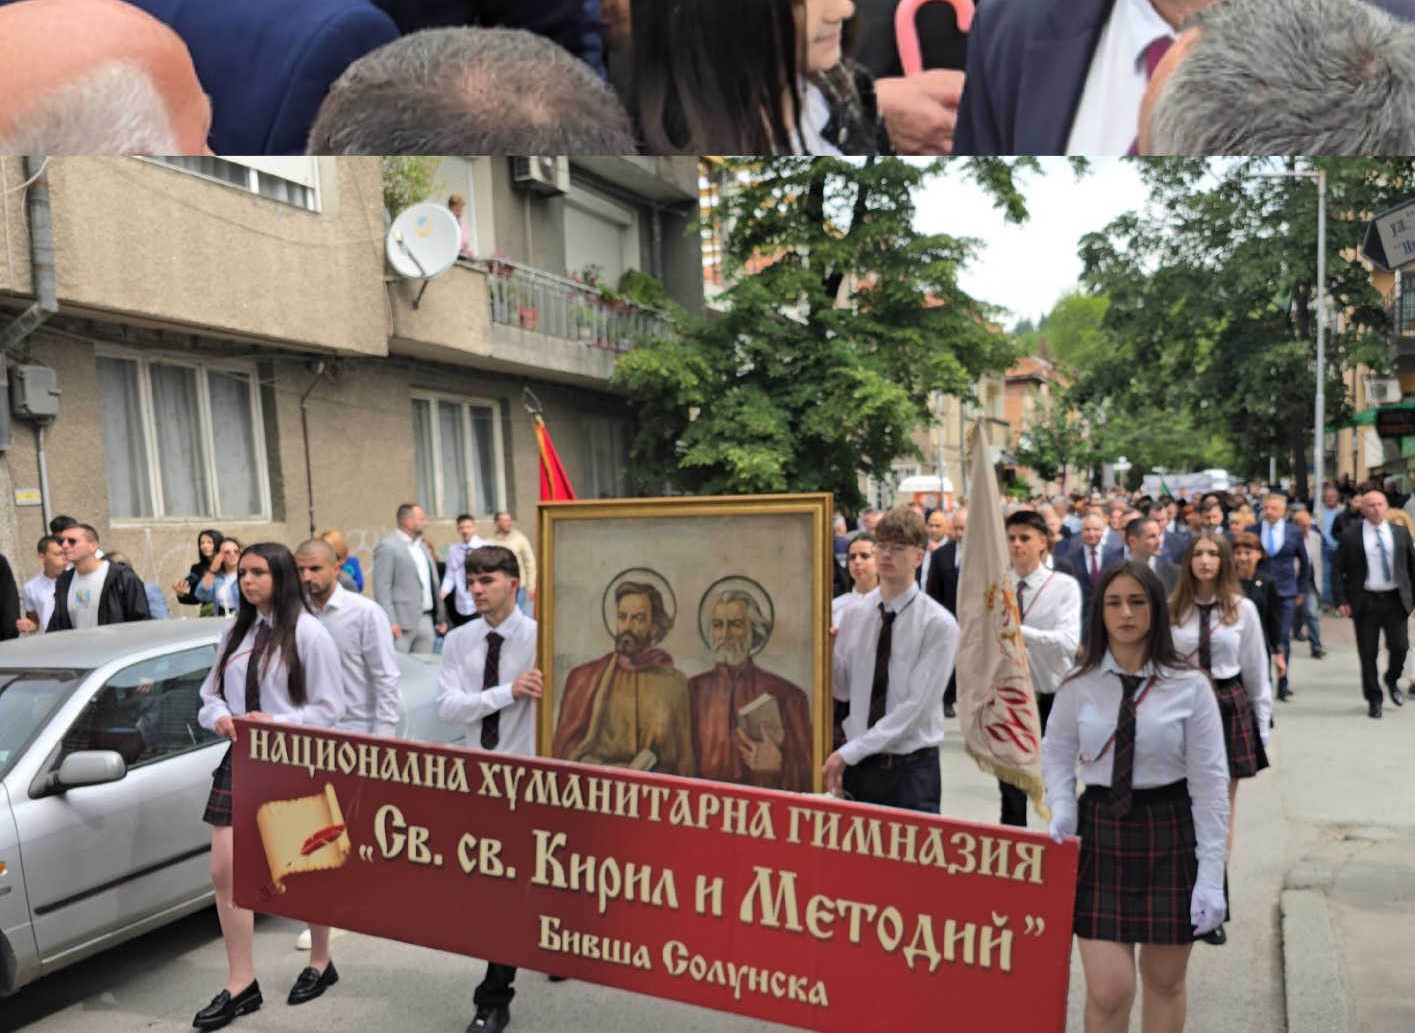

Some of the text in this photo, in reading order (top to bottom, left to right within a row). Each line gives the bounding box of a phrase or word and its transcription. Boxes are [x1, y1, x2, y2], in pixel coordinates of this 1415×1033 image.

[248, 727, 1046, 885] НАЦИОНАЛНА ХУМАНИТАРНА ГИМНАЗИЯ
[530, 828, 679, 915] Кирил
[694, 874, 724, 917] и
[538, 915, 829, 1008] Бивша Солунска
